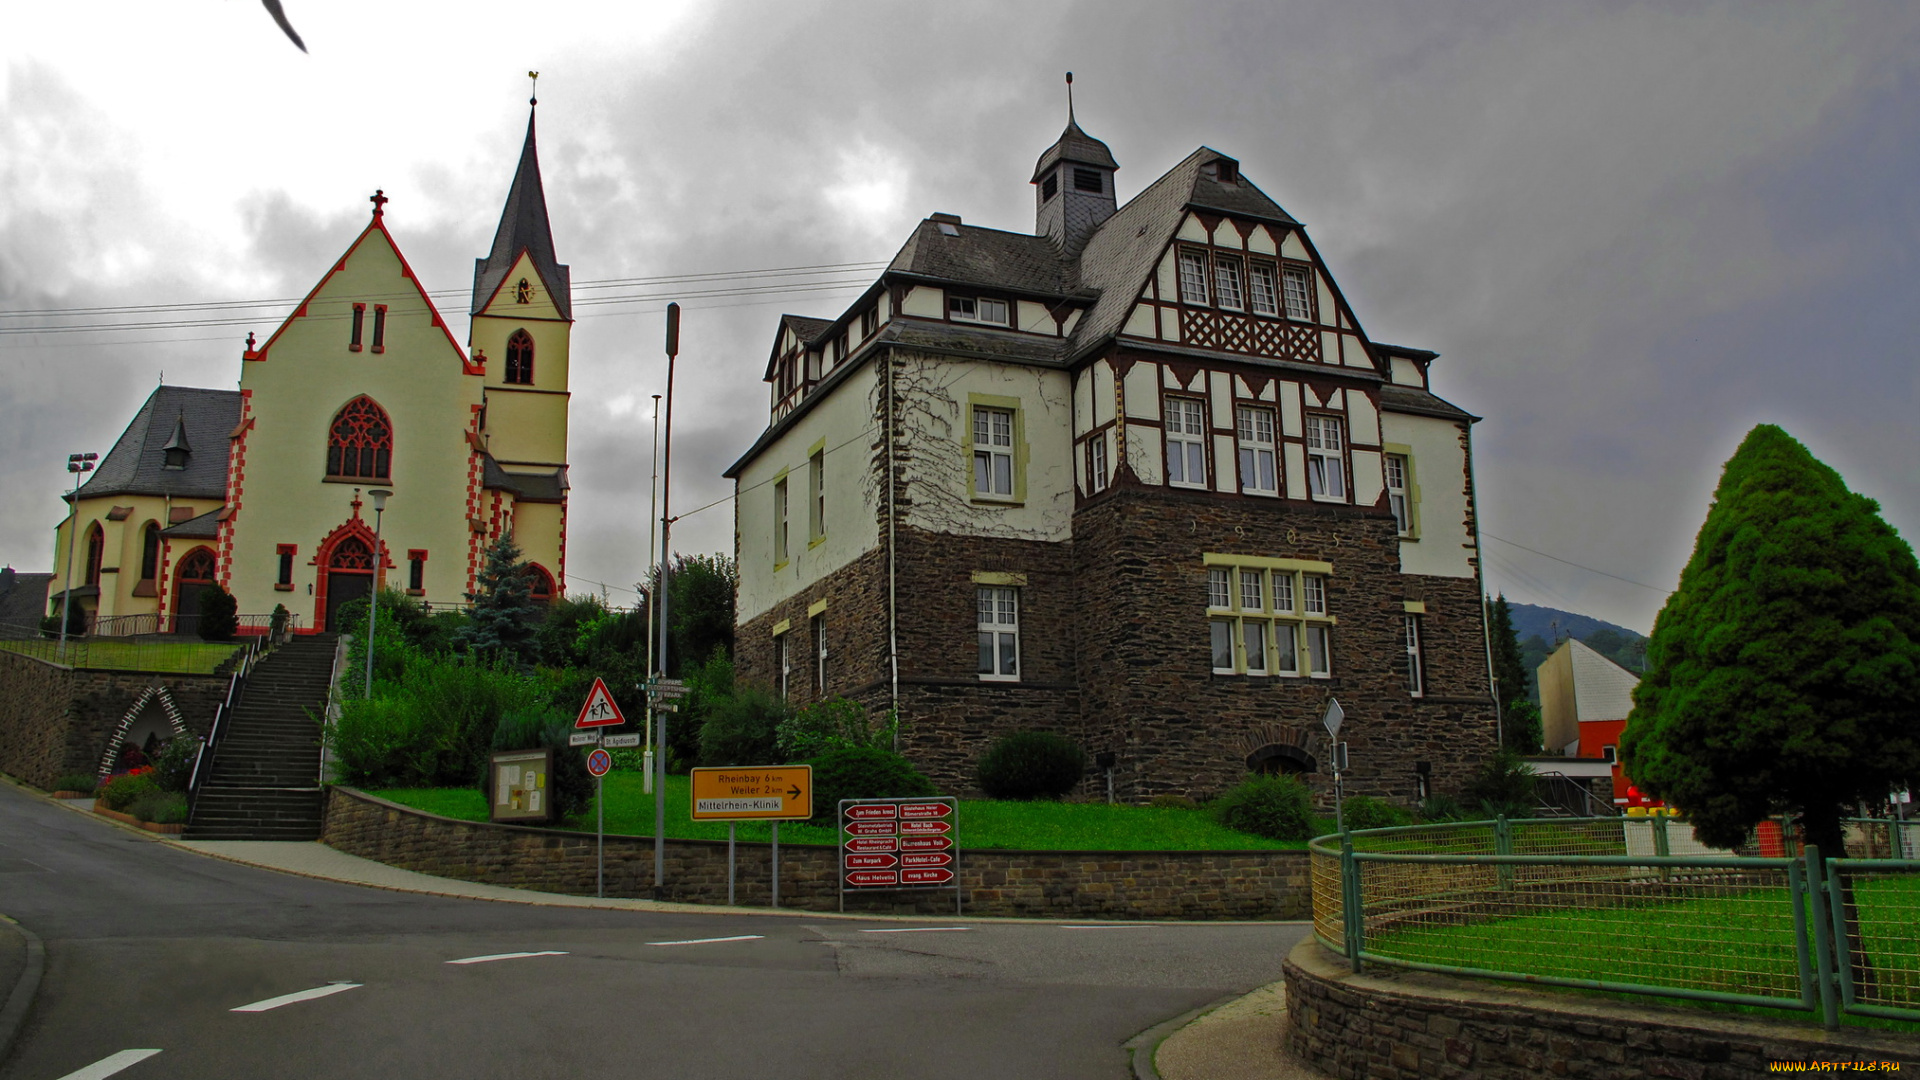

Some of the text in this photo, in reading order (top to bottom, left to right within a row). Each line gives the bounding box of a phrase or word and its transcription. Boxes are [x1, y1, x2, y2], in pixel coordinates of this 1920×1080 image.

[718, 773, 783, 784] Rheinbay 6 km
[730, 785, 783, 795] Weiler 2 km
[698, 799, 779, 810] Mittelrhein-Klinik
[863, 857, 881, 865] Kurpark
